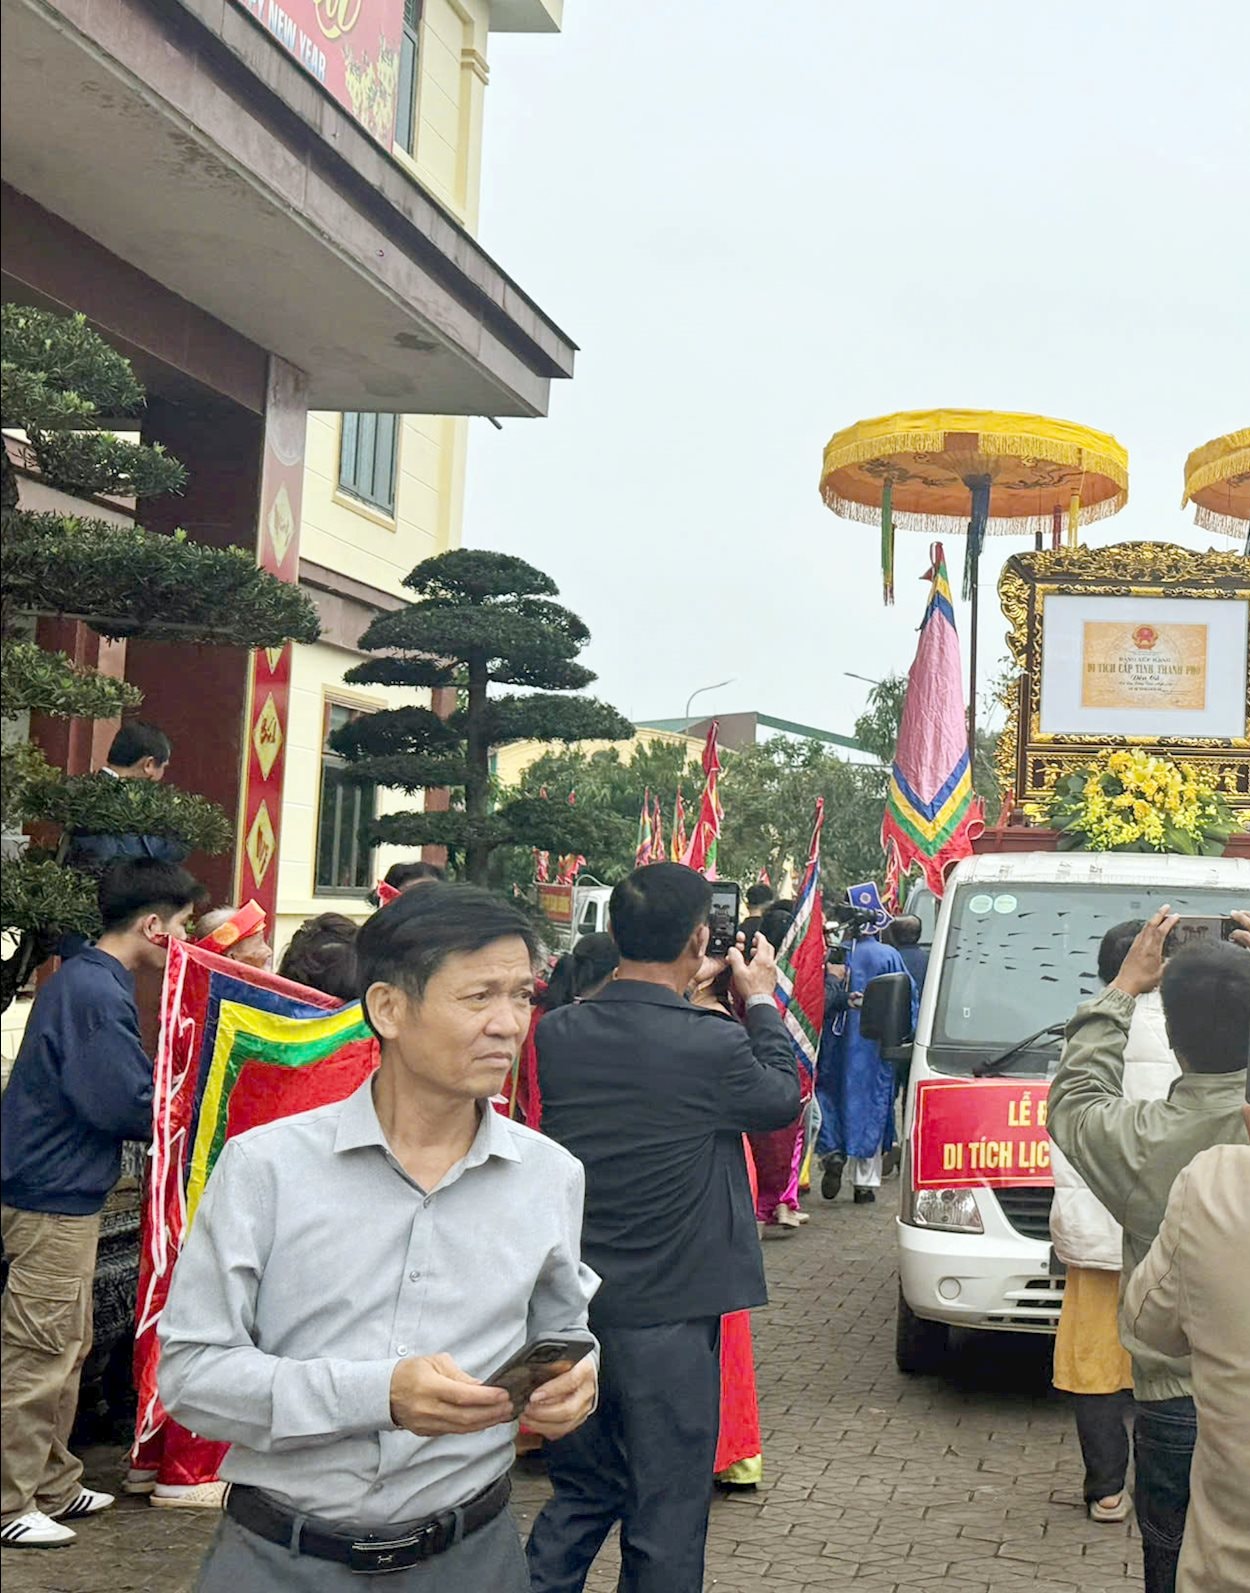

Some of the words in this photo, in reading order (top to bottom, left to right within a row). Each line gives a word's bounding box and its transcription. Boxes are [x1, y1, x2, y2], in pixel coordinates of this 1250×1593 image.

[268, 0, 297, 52] NEW
[300, 29, 326, 83] YEAR
[1008, 1091, 1031, 1126] LỄ
[943, 1143, 962, 1170] DI
[968, 1136, 1012, 1169] TÍCH
[1018, 1140, 1050, 1174] LỊC
